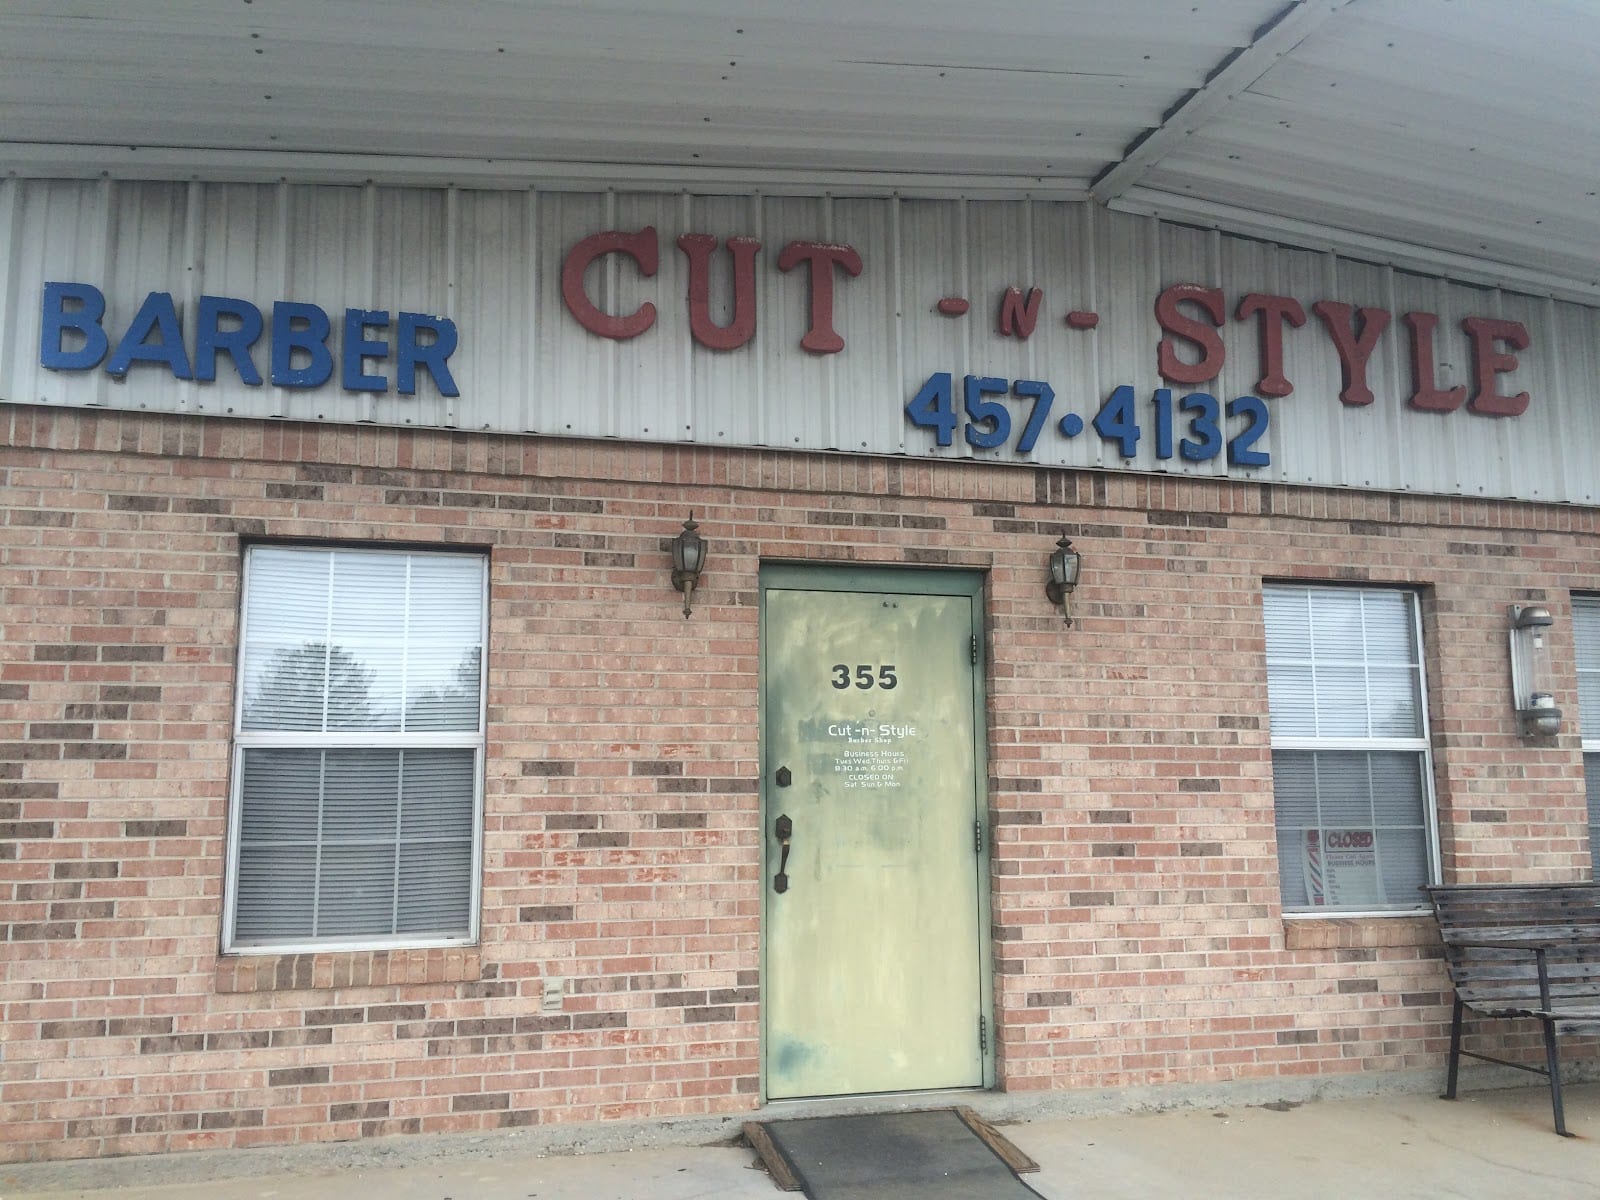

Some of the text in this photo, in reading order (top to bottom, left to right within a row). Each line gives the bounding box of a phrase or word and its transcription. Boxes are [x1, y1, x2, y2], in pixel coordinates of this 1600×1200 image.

[562, 226, 863, 354] CUT
[1154, 283, 1530, 417] STYLE
[40, 281, 461, 398] BARBER
[831, 664, 898, 690] 355
[828, 724, 852, 736] Cut
[879, 724, 917, 738] Style
[1327, 831, 1374, 848] CLOSED
